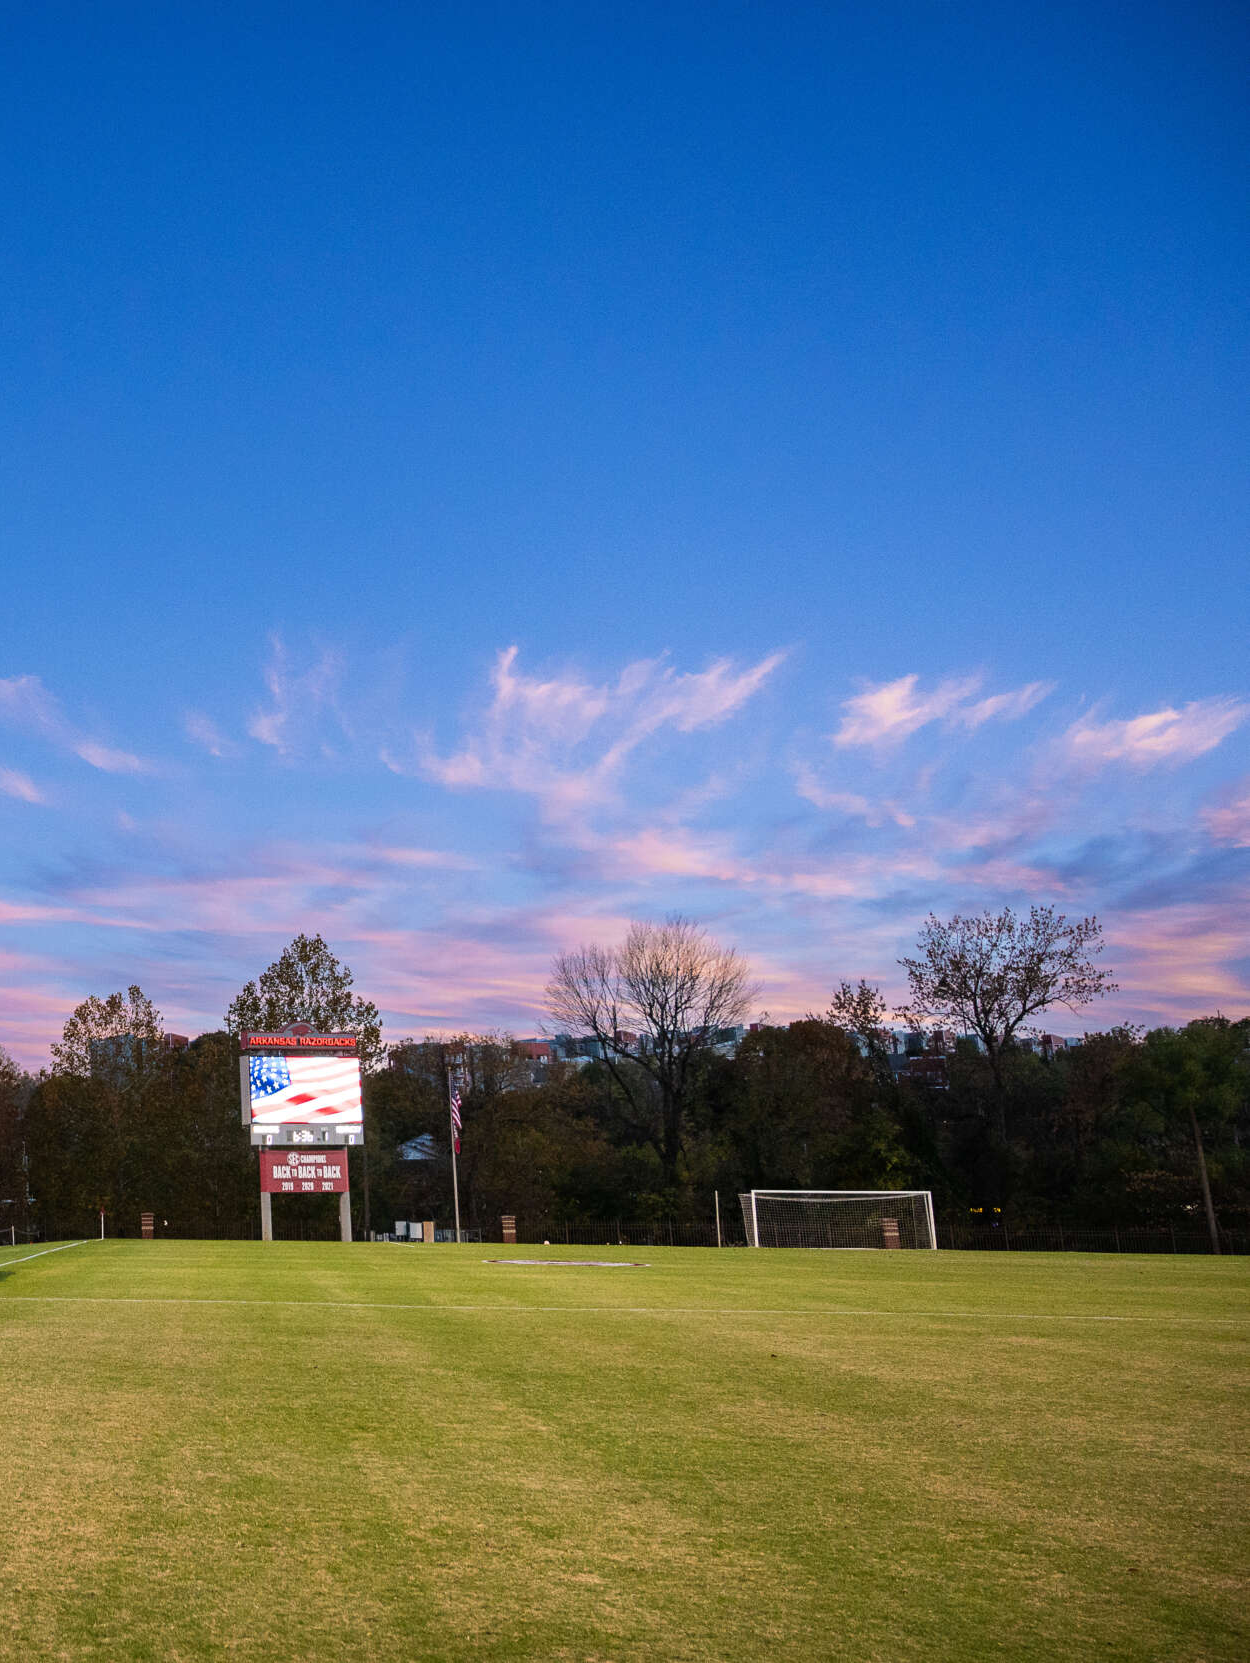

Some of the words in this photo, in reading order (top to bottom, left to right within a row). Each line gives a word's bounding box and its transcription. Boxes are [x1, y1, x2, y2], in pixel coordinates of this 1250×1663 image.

[249, 1037, 297, 1046] ARKANSAS
[299, 1037, 356, 1047] RAZORBACKS
[273, 1165, 291, 1179] BACK
[298, 1165, 316, 1179] BACK
[323, 1165, 341, 1179] BACK
